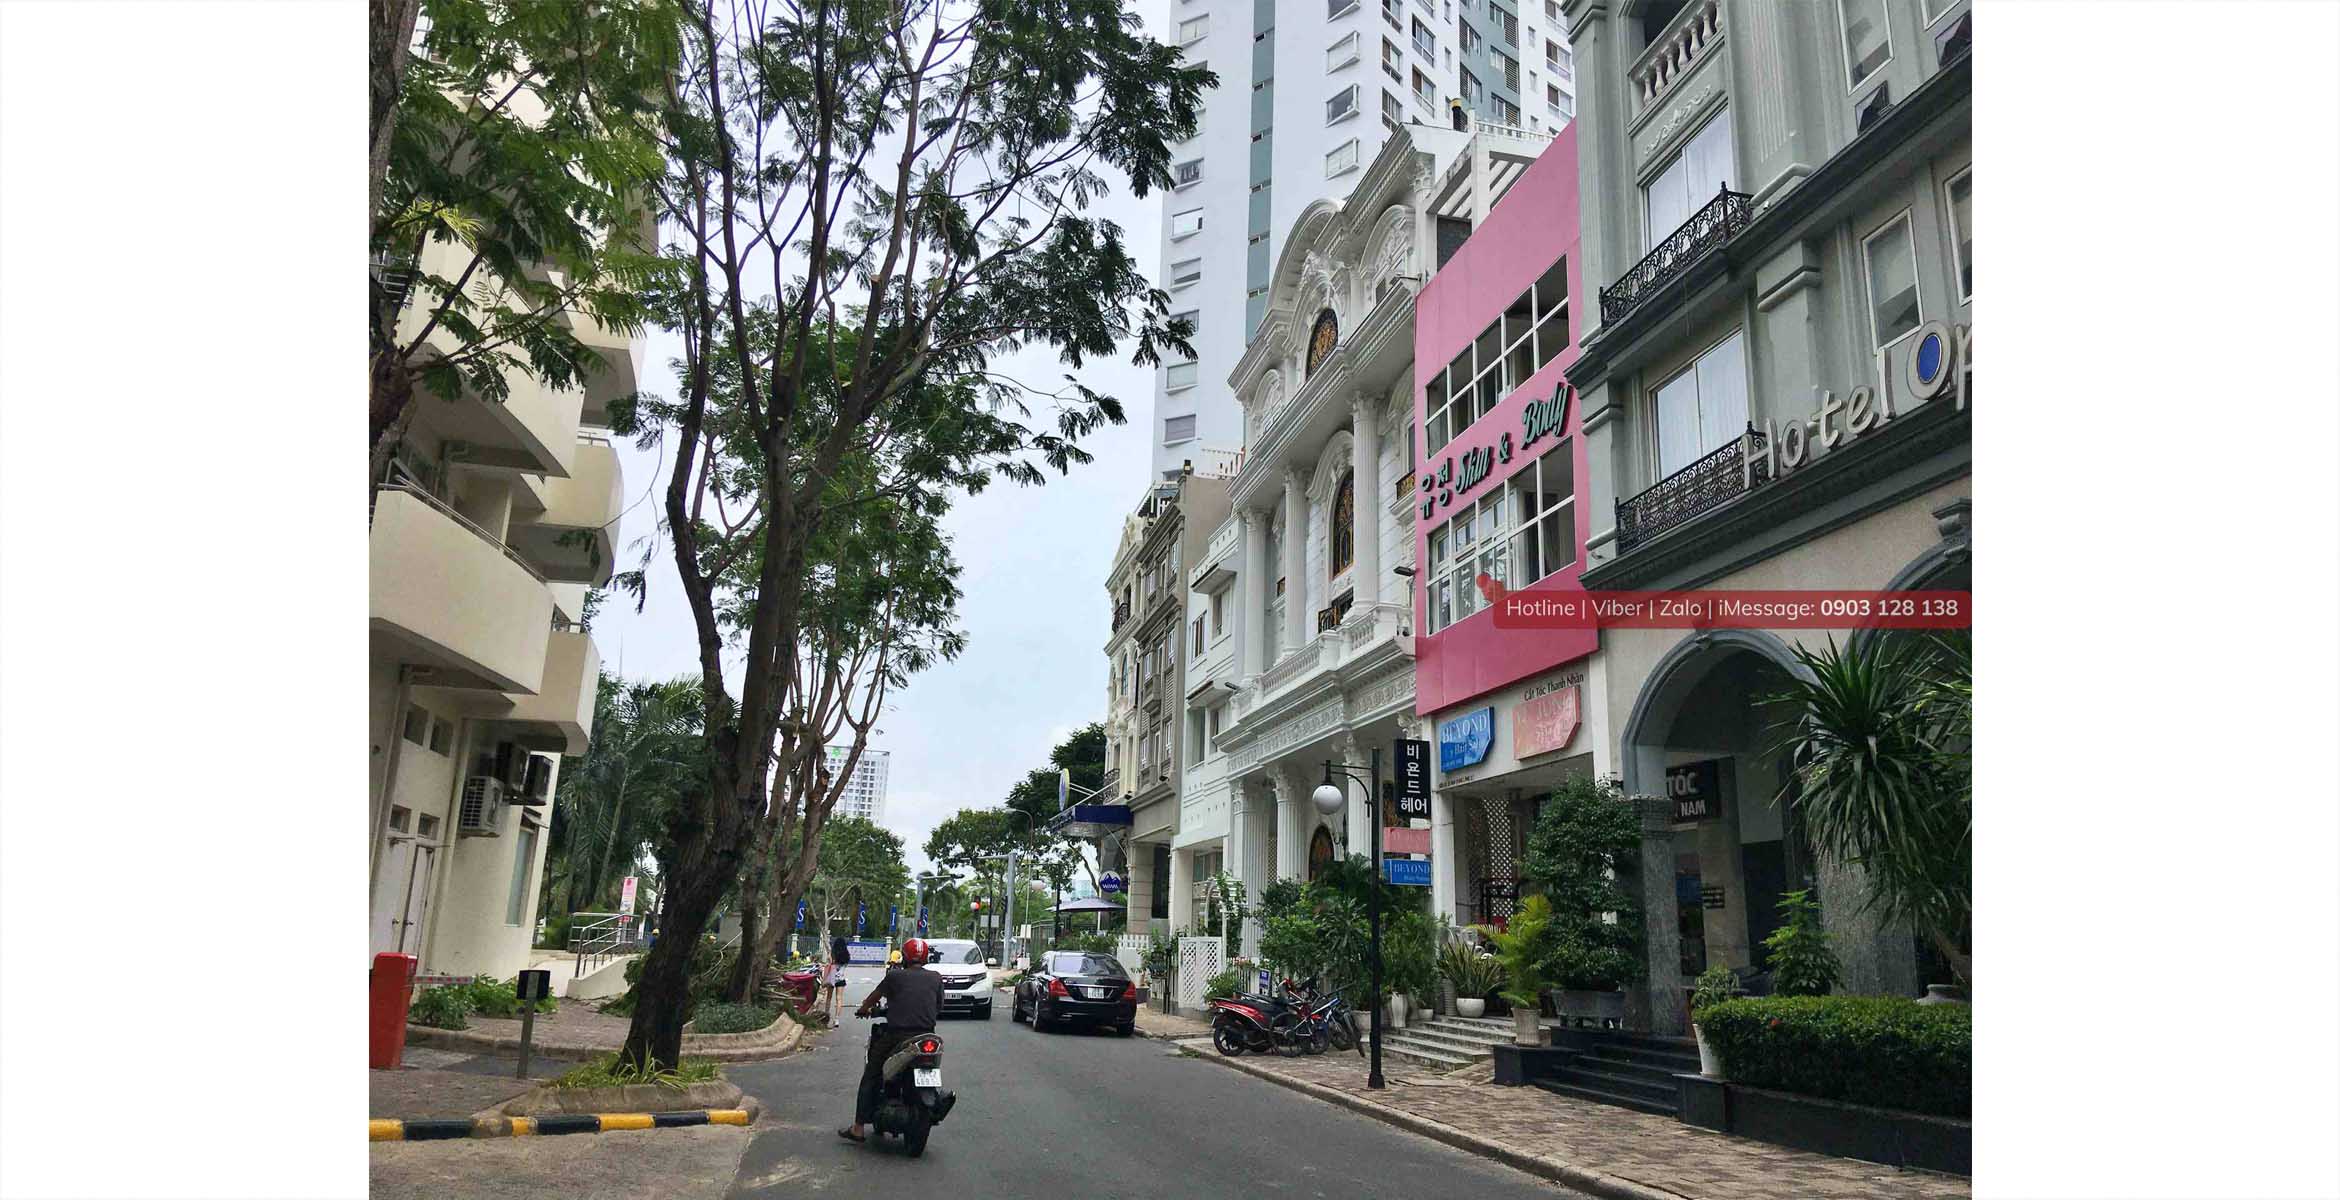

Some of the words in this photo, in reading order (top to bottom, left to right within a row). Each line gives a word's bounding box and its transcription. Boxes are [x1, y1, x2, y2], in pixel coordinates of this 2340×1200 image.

[1522, 384, 1572, 448] Body
[1742, 346, 1896, 490] Hotel
[1420, 457, 1452, 520] 유정
[1442, 714, 1487, 744] BEYOND
[1406, 743, 1421, 794] 비욘드
[1400, 797, 1427, 815] 헤어
[1680, 799, 1706, 817] NAM
[1394, 863, 1430, 874] BEYOND
